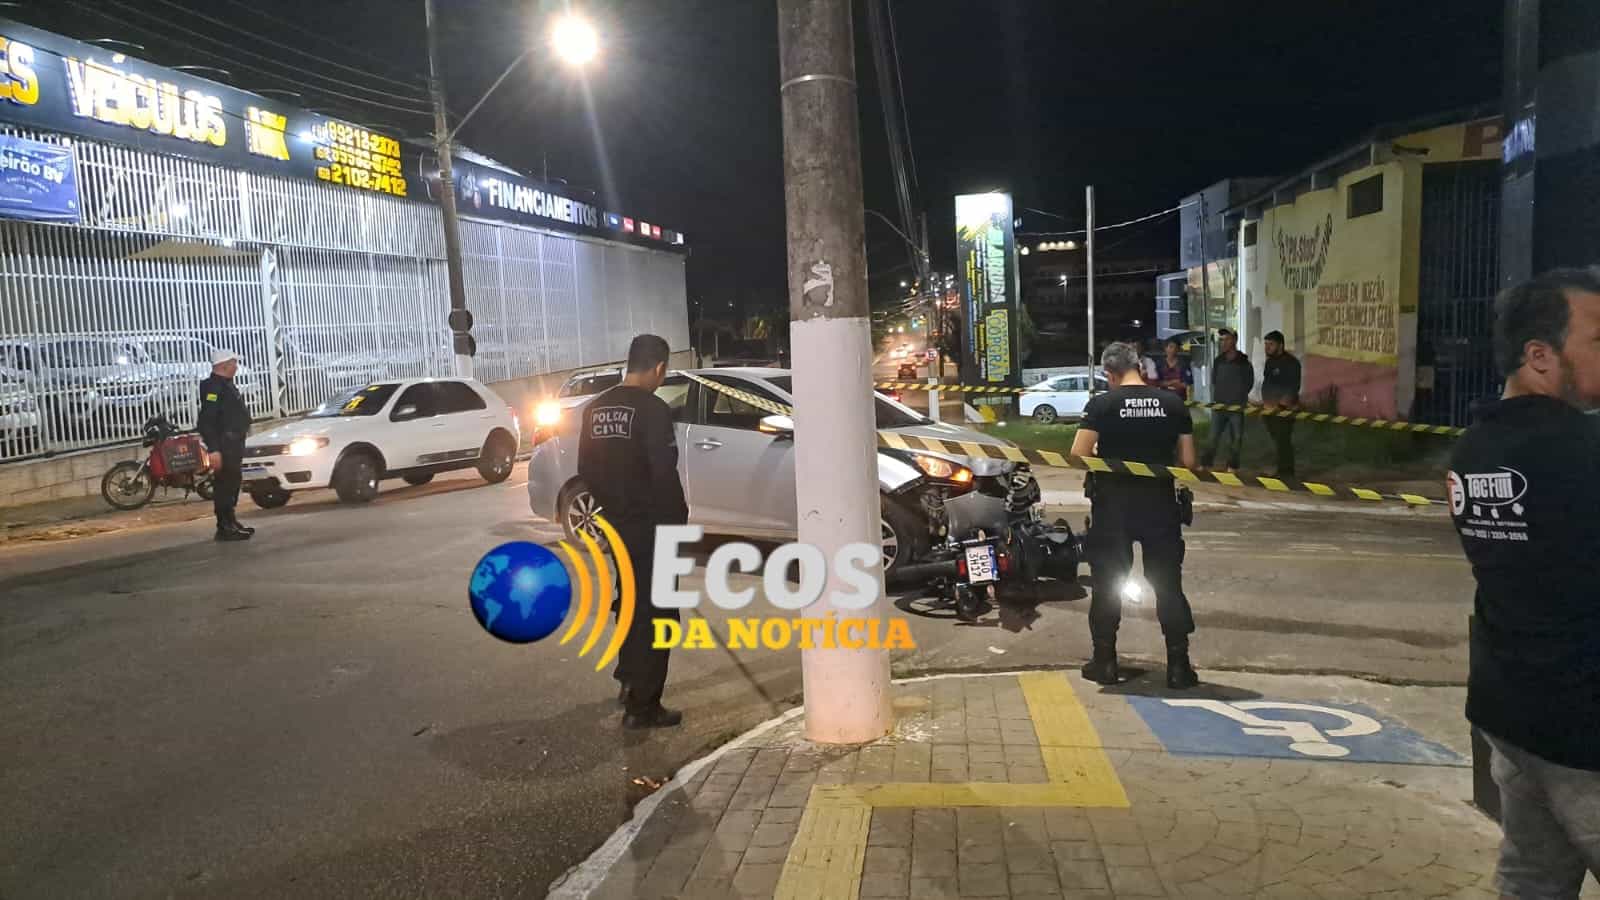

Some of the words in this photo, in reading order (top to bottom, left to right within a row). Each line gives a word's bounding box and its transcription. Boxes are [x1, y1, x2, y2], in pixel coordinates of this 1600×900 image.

[488, 178, 598, 228] FINANCIAMENTOS
[1125, 397, 1160, 408] PERITO
[1120, 407, 1168, 419] CRIMINAL
[592, 423, 628, 436] CIVIL
